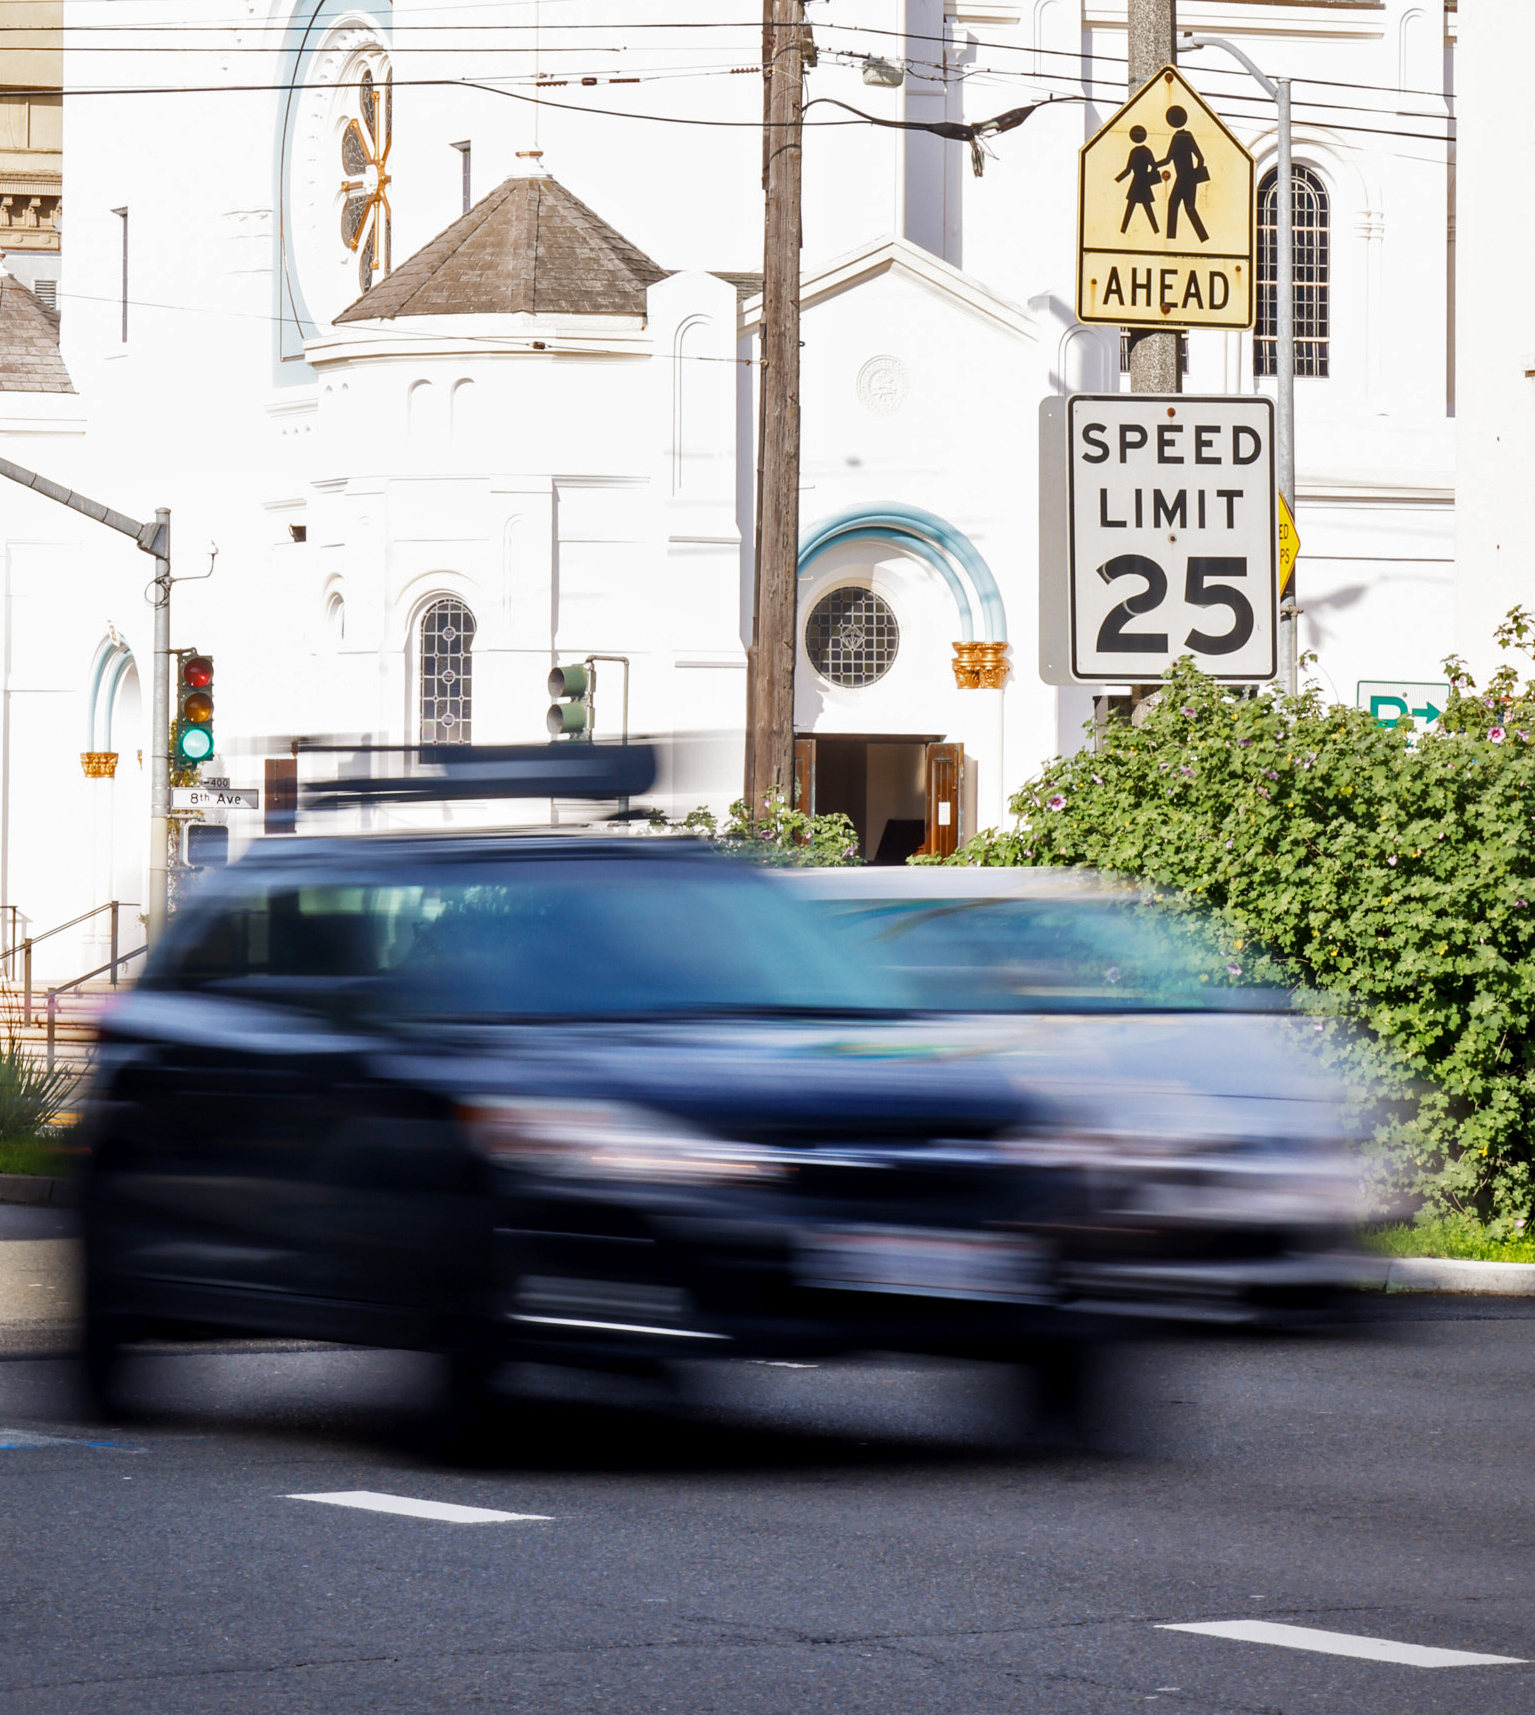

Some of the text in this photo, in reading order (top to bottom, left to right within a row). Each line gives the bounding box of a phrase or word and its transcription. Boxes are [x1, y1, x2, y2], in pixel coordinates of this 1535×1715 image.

[1102, 266, 1229, 310] AHEAD
[1081, 423, 1262, 465] SPEED
[1100, 488, 1244, 529] LIMIT
[1096, 554, 1254, 656] 25
[190, 792, 242, 805] 8th Ave
